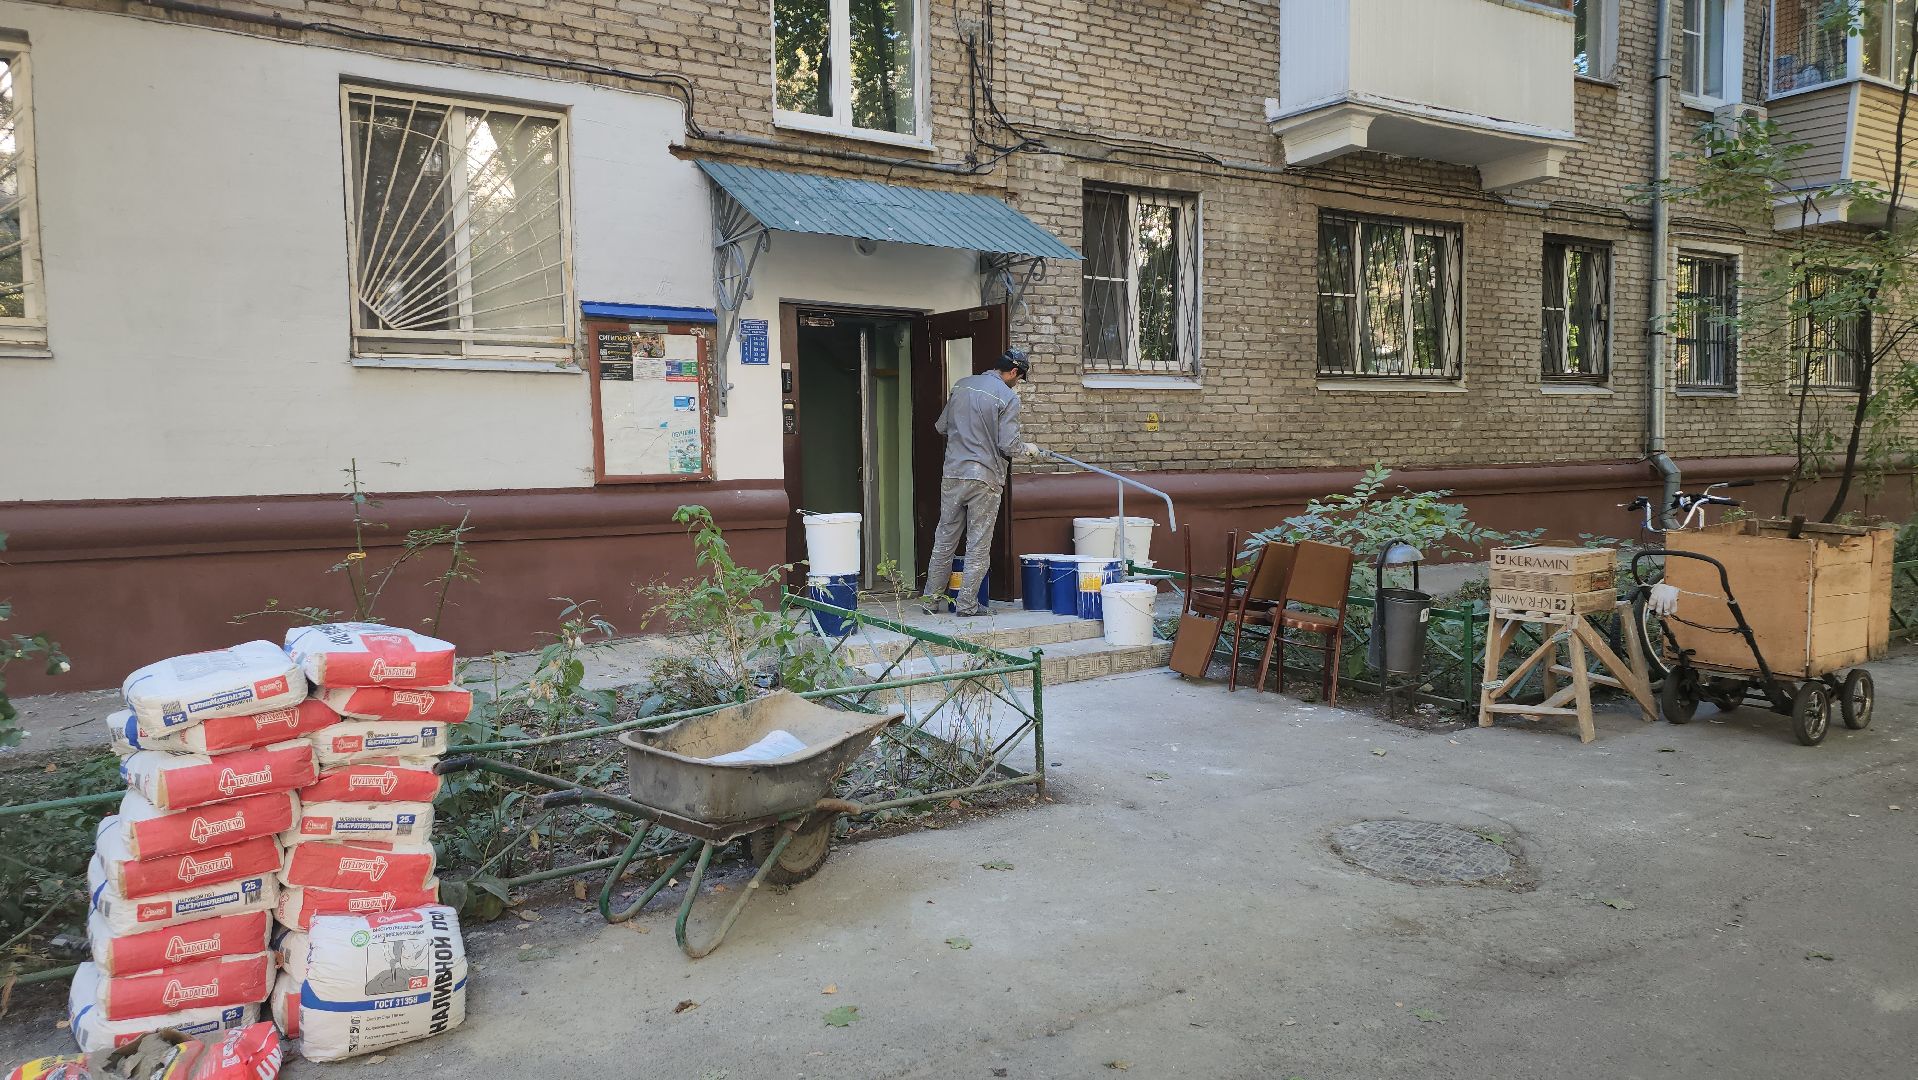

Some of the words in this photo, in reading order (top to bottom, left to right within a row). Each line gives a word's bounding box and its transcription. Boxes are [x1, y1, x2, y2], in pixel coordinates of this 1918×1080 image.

[1509, 554, 1569, 571] KERAMIN
[1495, 593, 1552, 610] KERAMIN
[244, 881, 257, 891] 25
[410, 979, 423, 989] 25
[428, 936, 454, 1035] НАЛИВНОЙ
[374, 998, 394, 1010] ГОСТ
[225, 1009, 237, 1020] 25
